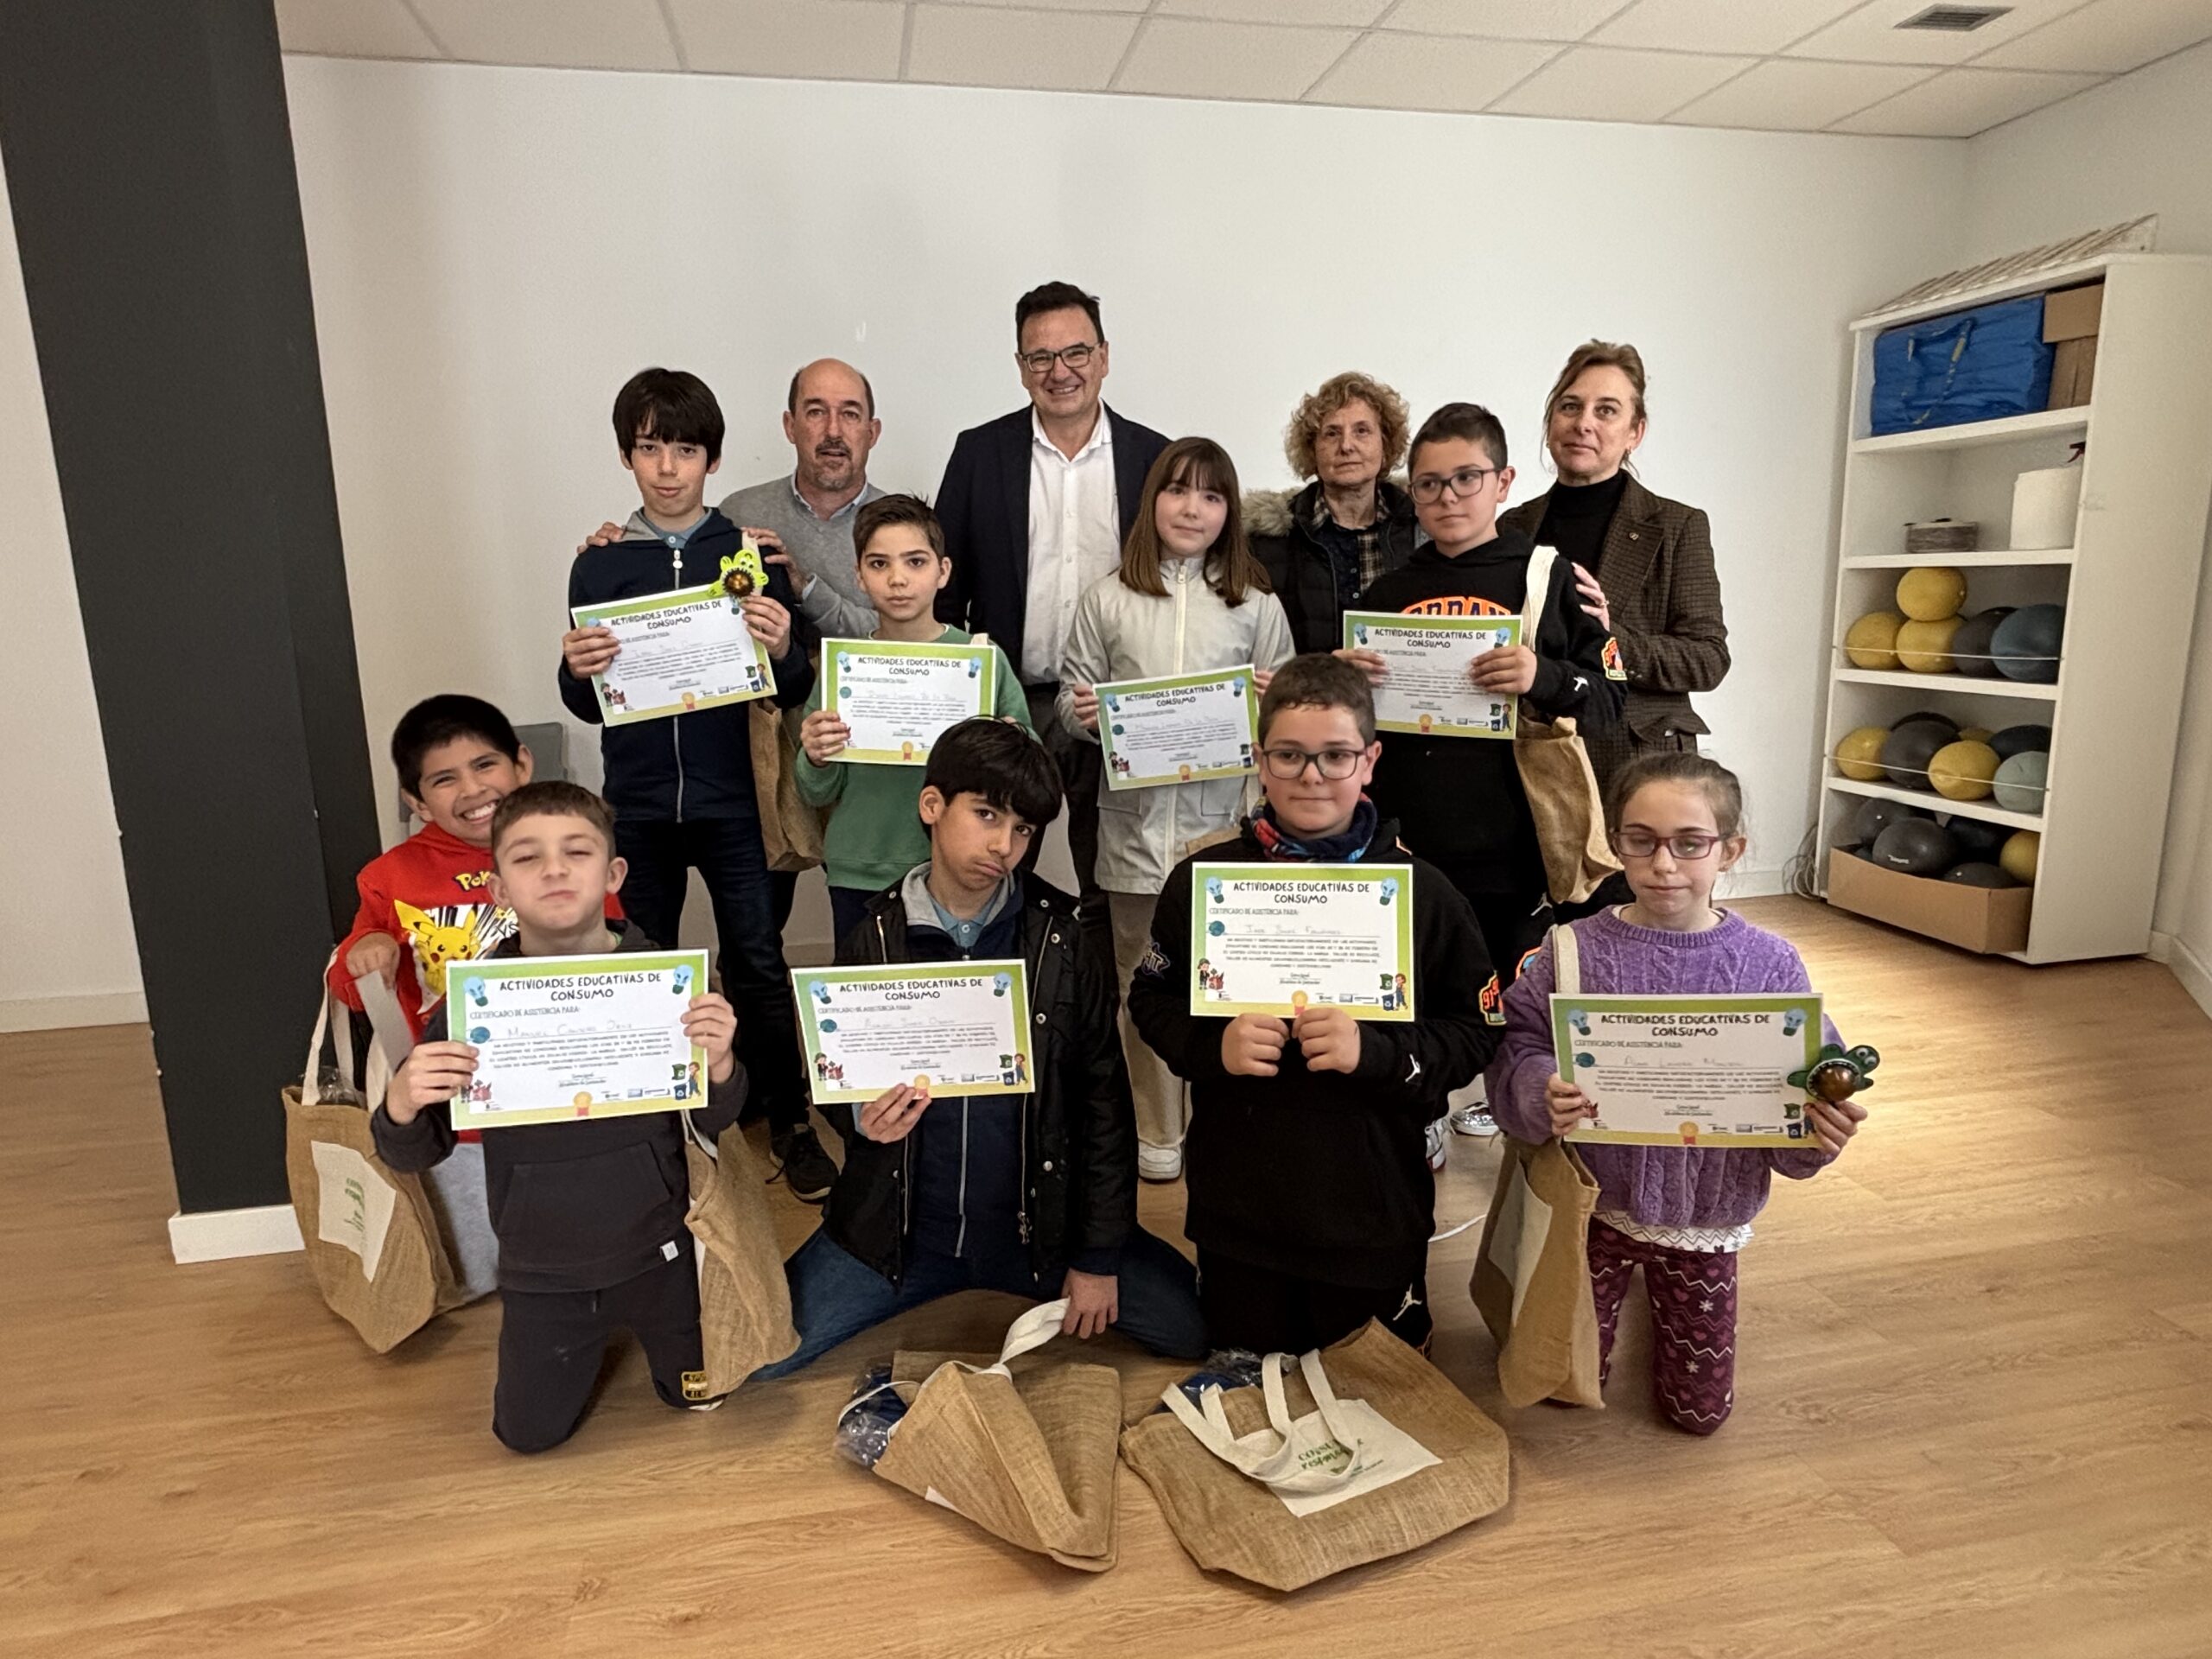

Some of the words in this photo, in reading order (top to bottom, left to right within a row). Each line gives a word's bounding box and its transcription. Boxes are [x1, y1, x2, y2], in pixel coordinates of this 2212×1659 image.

[611, 612, 661, 626] ACTIVIDADES
[664, 602, 710, 618] EDUCATIVAS
[712, 601, 721, 609] DE
[647, 617, 691, 630] CONSUMO
[1375, 629, 1423, 638] ACTIVIDADES
[1408, 639, 1450, 648] CONSUMO
[858, 657, 903, 665] ACTIVIDADES
[1125, 690, 1170, 702] ACTIVIDADES
[1172, 686, 1214, 696] EDUCATIVAS
[1156, 696, 1196, 707] CONSUMO
[1234, 882, 1294, 893] ACTIVIDADES
[1297, 883, 1354, 892] EDUCATIVAS
[1274, 894, 1327, 904] CONSUMO
[499, 978, 574, 991] ACTIVIDADES
[578, 974, 643, 987] EDUCATIVAS
[648, 973, 661, 982] DE
[840, 982, 904, 993] ACTIVIDADES
[907, 979, 966, 989] EDUCATIVAS
[970, 978, 982, 987] DE
[551, 989, 613, 1001] CONSUMO
[886, 991, 940, 1001] CONSUMO
[1601, 1014, 1675, 1024] ACTIVIDADES
[1679, 1015, 1751, 1024] EDUCATIVAS
[1755, 1015, 1770, 1024] DE
[1652, 1027, 1718, 1036] CONSUMO
